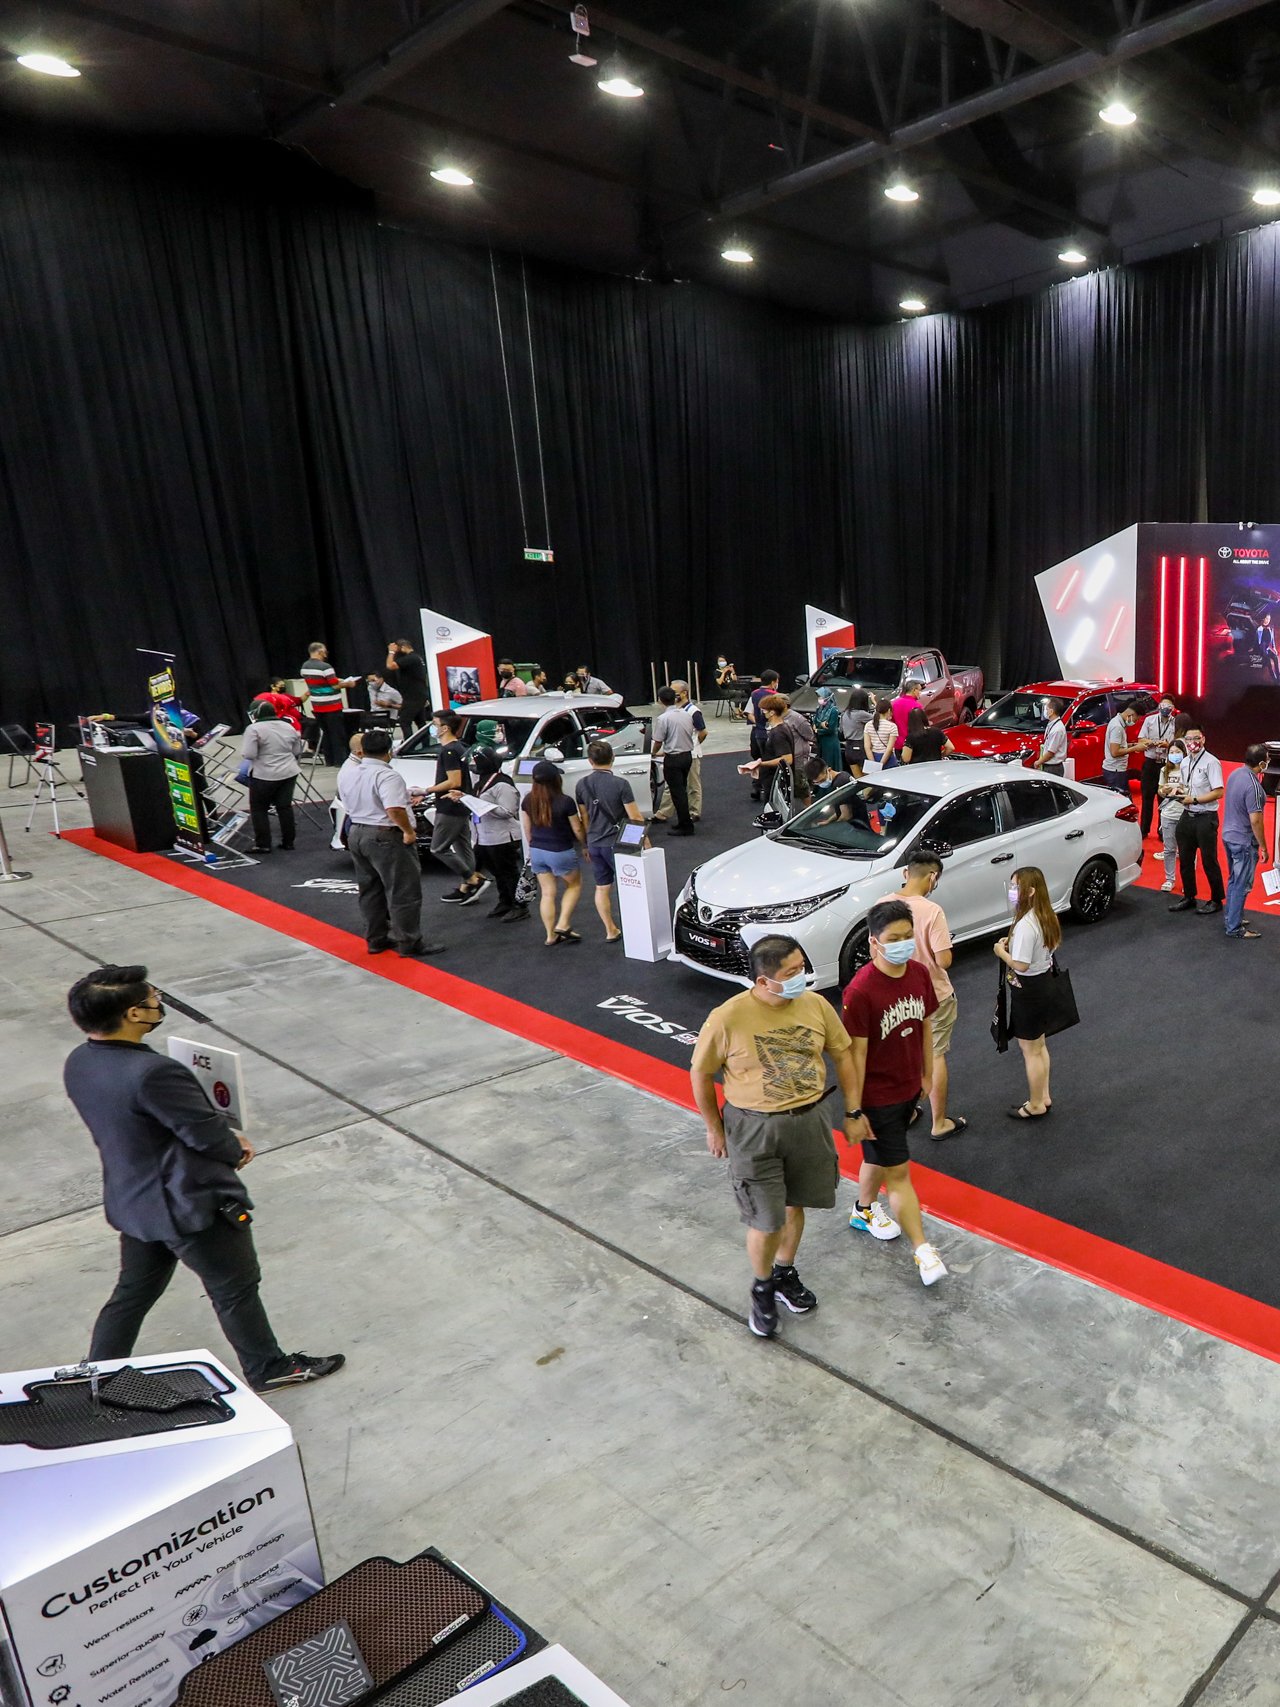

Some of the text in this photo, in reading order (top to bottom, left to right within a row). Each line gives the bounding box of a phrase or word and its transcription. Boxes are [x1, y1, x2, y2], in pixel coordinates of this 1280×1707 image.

[1233, 548, 1269, 558] TOYOTA
[620, 876, 642, 885] TOYOTA
[688, 932, 710, 946] VIOS
[596, 996, 687, 1034] VIOS
[615, 994, 648, 1006] NEW
[41, 1486, 275, 1619] Customization
[88, 1524, 244, 1615] Perfect Fit Your Vehicle
[216, 1532, 285, 1574] Dust Trap Design
[221, 1563, 280, 1601] Anti-Bacterial
[227, 1601, 261, 1625] Comfort
[268, 1577, 304, 1603] Hygiene
[83, 1605, 156, 1650] Wear-resistant
[89, 1630, 167, 1679] Superior-quality
[98, 1657, 171, 1704] Water Resistant
